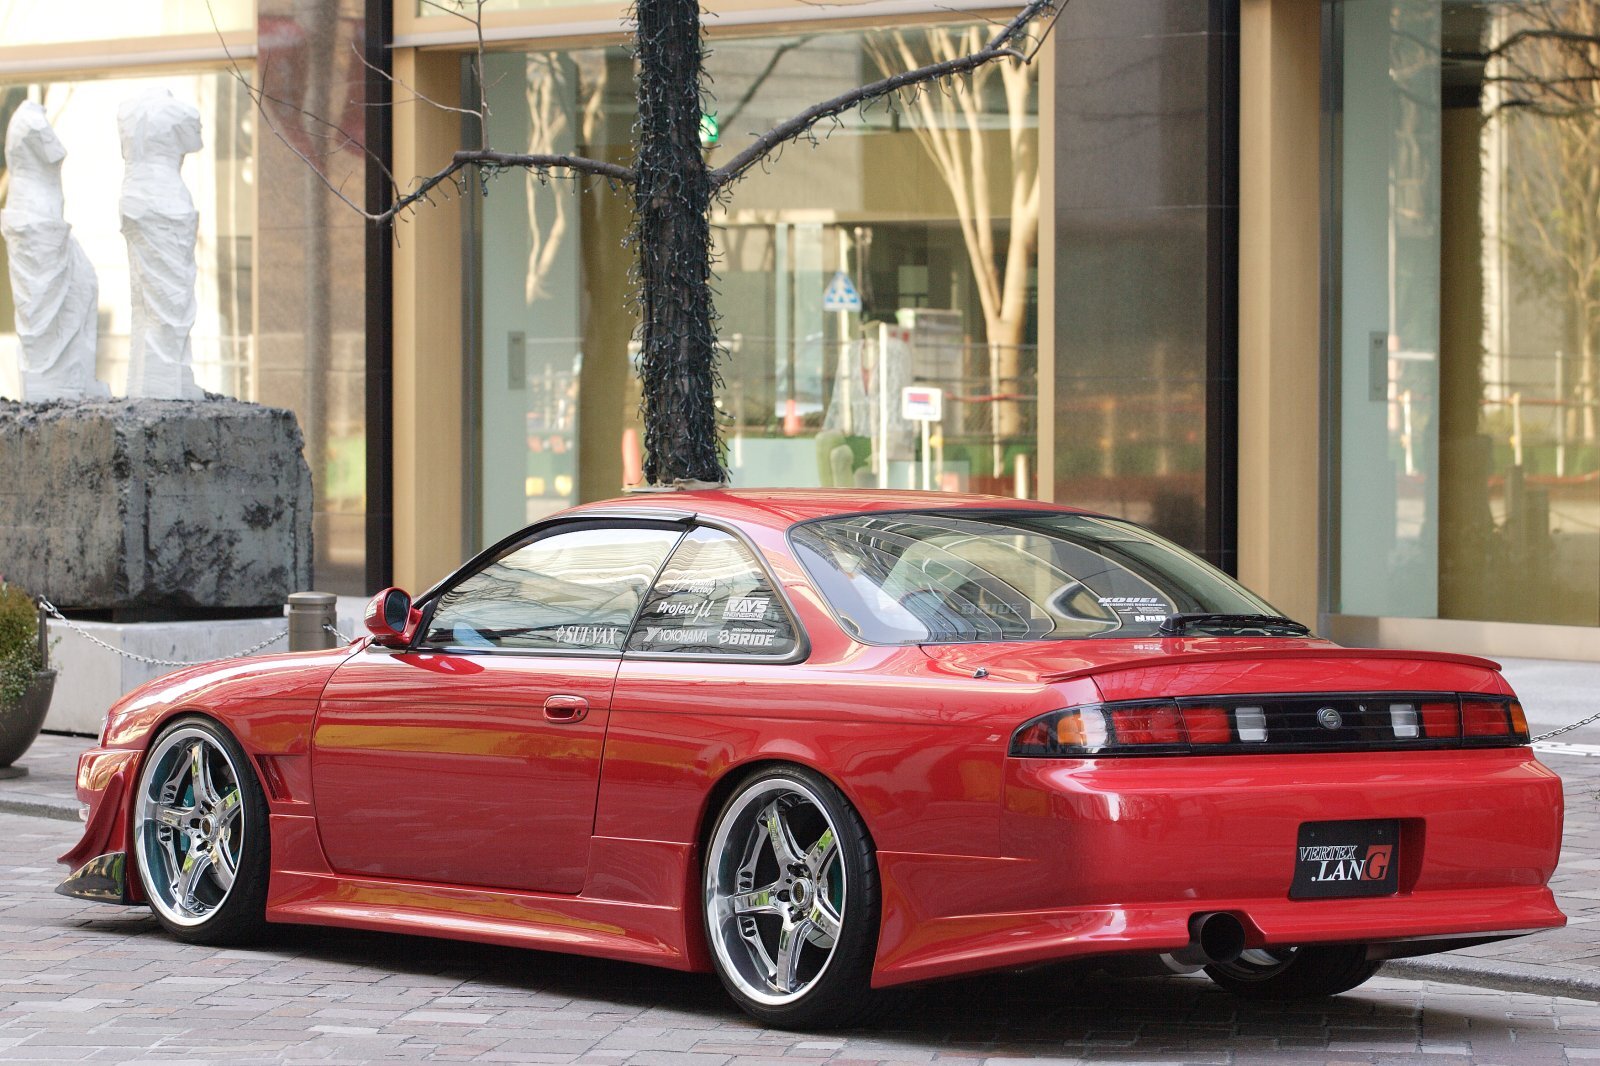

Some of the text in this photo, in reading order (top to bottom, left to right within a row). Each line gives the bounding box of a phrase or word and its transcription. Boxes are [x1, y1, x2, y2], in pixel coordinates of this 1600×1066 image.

[657, 601, 699, 616] Project
[725, 599, 770, 613] RAYS
[659, 629, 708, 643] YOKOHAMA
[729, 633, 775, 646] BRIDE
[1299, 845, 1358, 862] VERTEX
